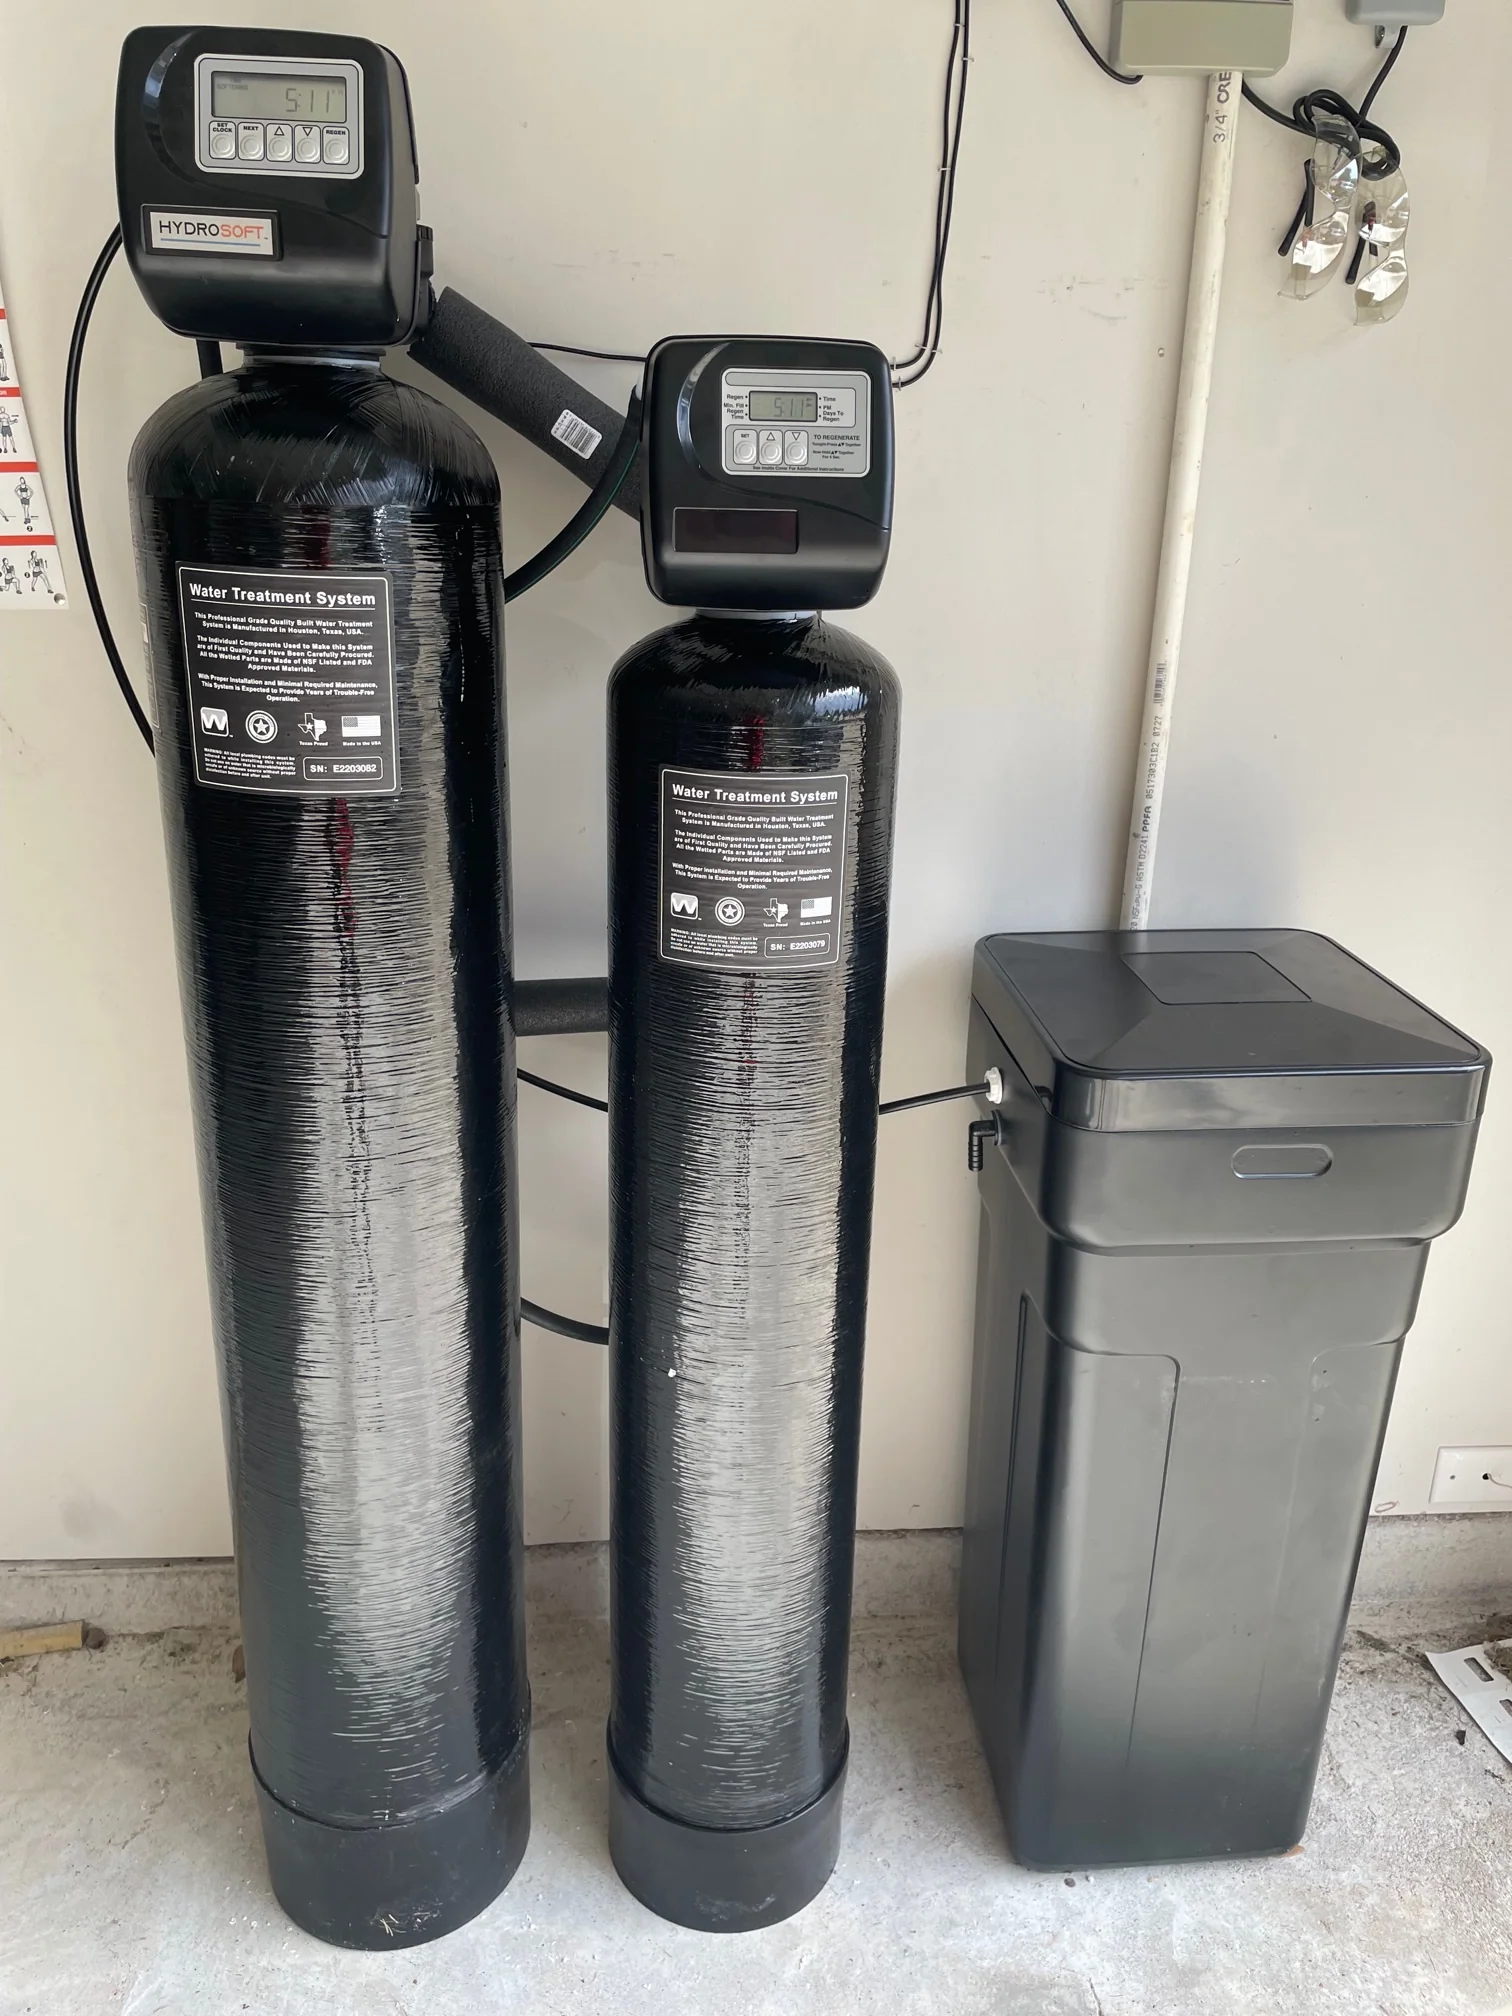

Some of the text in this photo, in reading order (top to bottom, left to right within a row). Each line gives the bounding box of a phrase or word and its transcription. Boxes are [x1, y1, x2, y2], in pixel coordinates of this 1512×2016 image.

[286, 88, 330, 113] 5:11
[1213, 110, 1228, 143] 3/4"
[159, 220, 264, 239] HYDROSOFT
[189, 583, 375, 607] Water Treatment System
[208, 614, 246, 622] Professional
[270, 618, 294, 626] Quality
[233, 624, 277, 632] Manufactured
[209, 637, 237, 645] Individual
[240, 640, 281, 648] Components
[230, 646, 252, 655] Quality
[333, 764, 377, 772] E2203082
[672, 784, 838, 804] Water Treatment System
[1142, 806, 1152, 832] PPFA
[790, 940, 825, 950] E2203079
